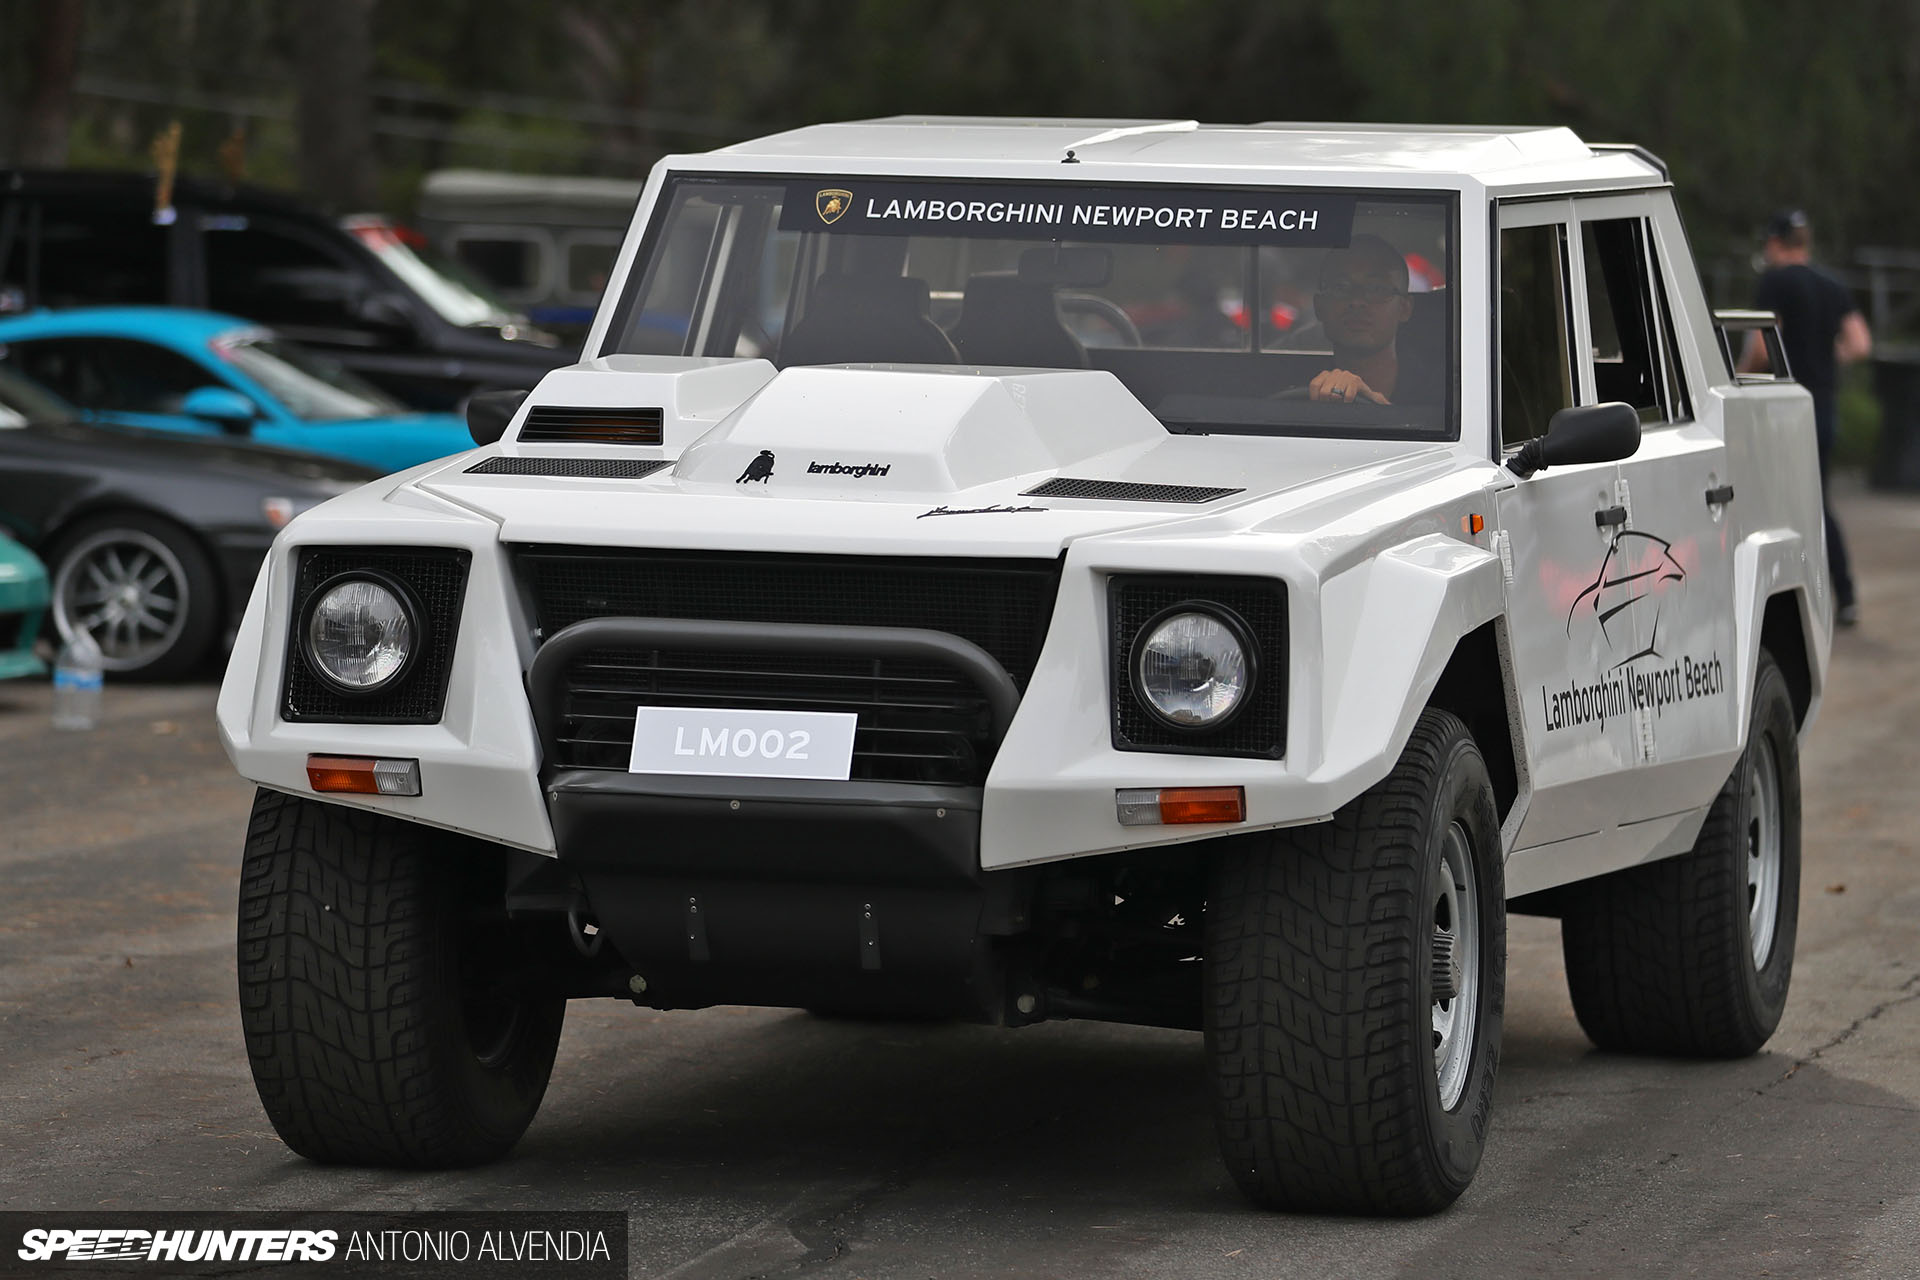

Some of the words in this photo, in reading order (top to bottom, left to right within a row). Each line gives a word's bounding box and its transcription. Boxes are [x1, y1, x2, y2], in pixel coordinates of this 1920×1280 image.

[866, 198, 1064, 224] LAMBORGHINI
[1071, 205, 1214, 229] NEWPORT
[1220, 209, 1319, 231] BEACH
[806, 461, 891, 479] lamborghini
[1542, 669, 1626, 734] Lamborghini
[1626, 659, 1683, 720] Newport
[1684, 650, 1724, 700] Beach
[674, 726, 811, 760] LM002
